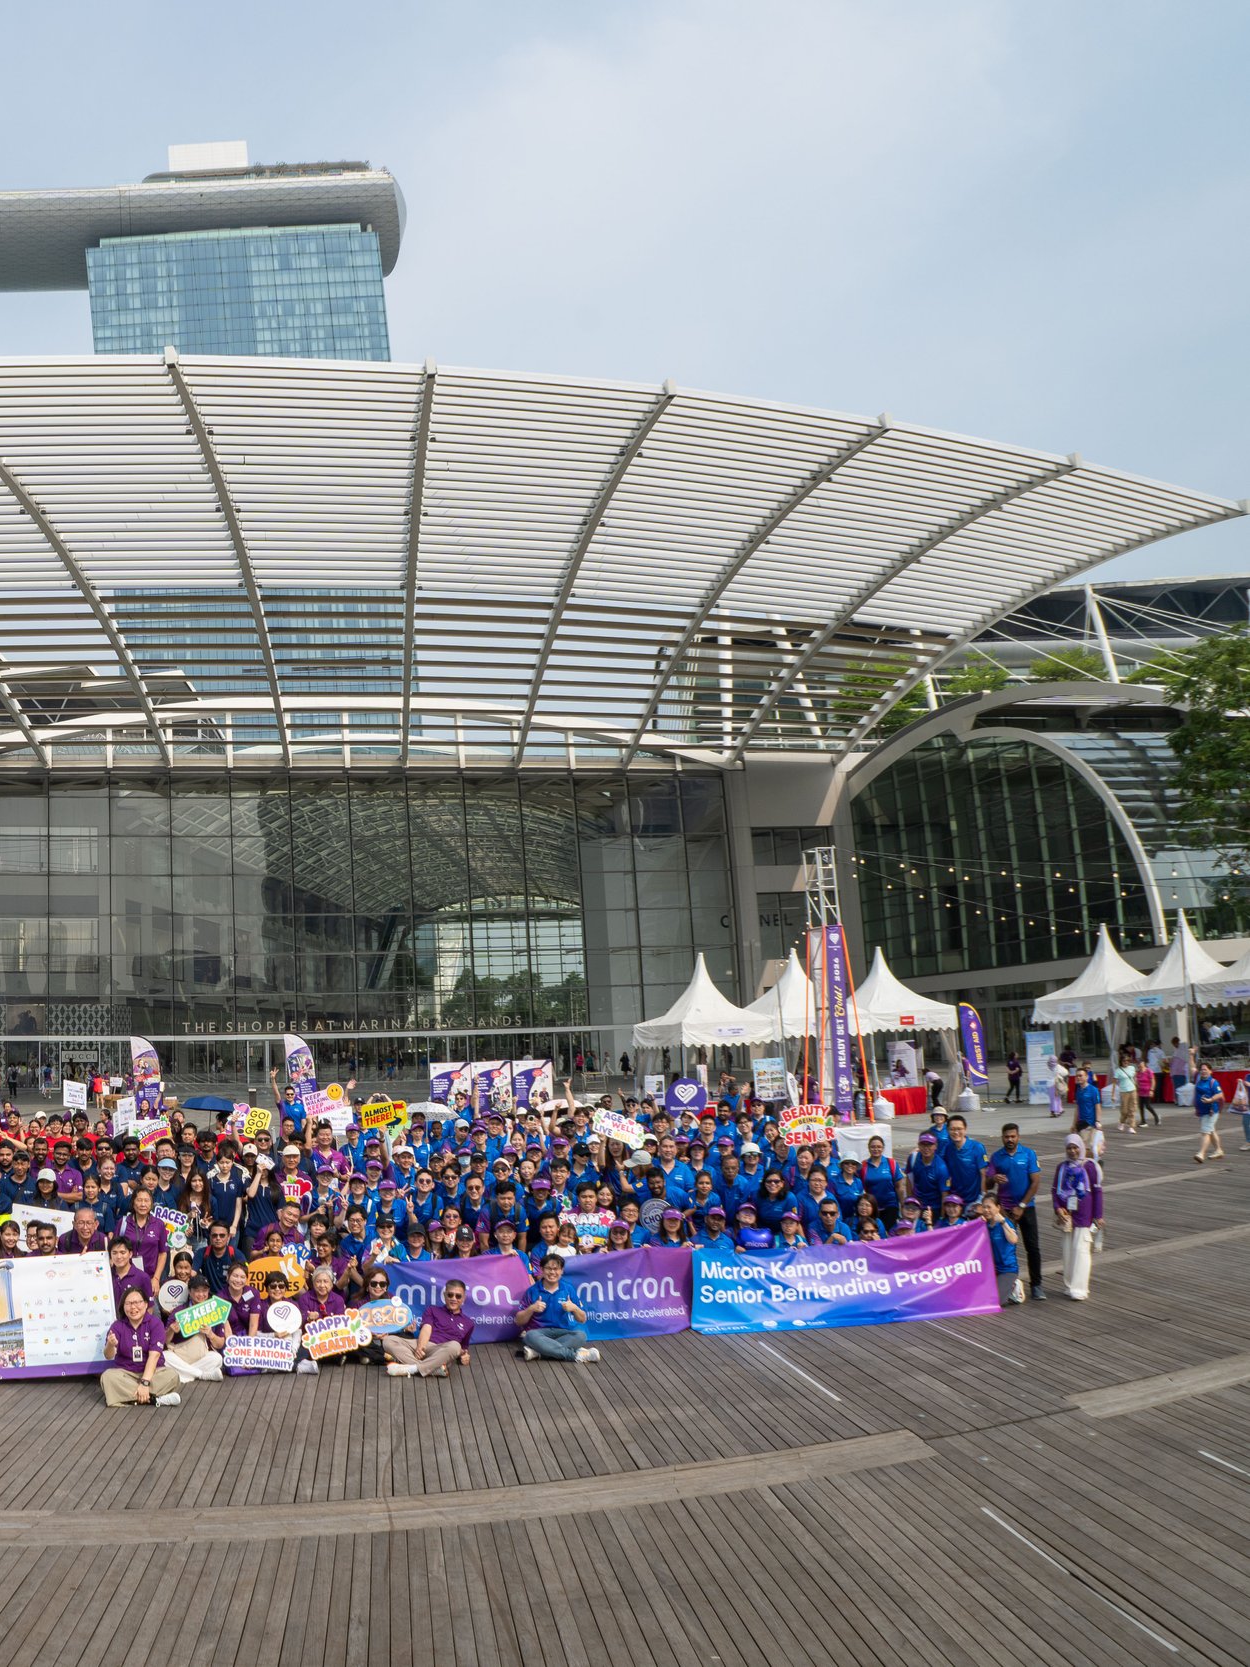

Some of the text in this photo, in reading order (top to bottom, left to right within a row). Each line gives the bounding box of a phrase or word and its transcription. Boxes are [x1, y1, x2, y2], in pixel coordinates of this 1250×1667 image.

[720, 914, 793, 928] CNEL
[182, 1015, 523, 1033] THE SHOPPES AT MARINA BAY SANDS
[838, 1019, 846, 1036] SET
[837, 1038, 847, 1068] READY
[971, 1031, 984, 1064] FIRST AID
[305, 1093, 321, 1101] KEEP
[306, 1096, 329, 1106] WALKING
[307, 1102, 324, 1111] KEEP
[310, 1104, 335, 1116] MILING
[364, 1104, 391, 1118] ALMOST
[782, 1105, 829, 1122] BEAUTY
[250, 1110, 270, 1120] GO!
[365, 1111, 392, 1126] THERE!
[603, 1112, 623, 1124] AGE
[798, 1117, 817, 1125] BEING
[247, 1120, 268, 1129] GO!
[594, 1124, 613, 1136] LIVE
[611, 1121, 636, 1134] WELL
[785, 1127, 835, 1145] SENIOR
[155, 1207, 187, 1226] RACES
[701, 1257, 868, 1280] Micron Kampong
[250, 1281, 300, 1293] BUES
[577, 1272, 681, 1302] micron
[701, 1259, 982, 1304] Senior Befriending Program
[395, 1277, 520, 1306] mion
[192, 1300, 218, 1321] KEEP
[360, 1305, 408, 1326] 2026
[568, 1306, 686, 1324] Inlligence Accelerated
[183, 1307, 224, 1335] GOING!
[307, 1316, 350, 1336] HAPPY
[227, 1336, 291, 1351] ONE PEOPLE
[310, 1336, 357, 1358] HEALTH
[233, 1348, 287, 1359] ONE NATION
[225, 1357, 293, 1370] ONE COMMUNITY
